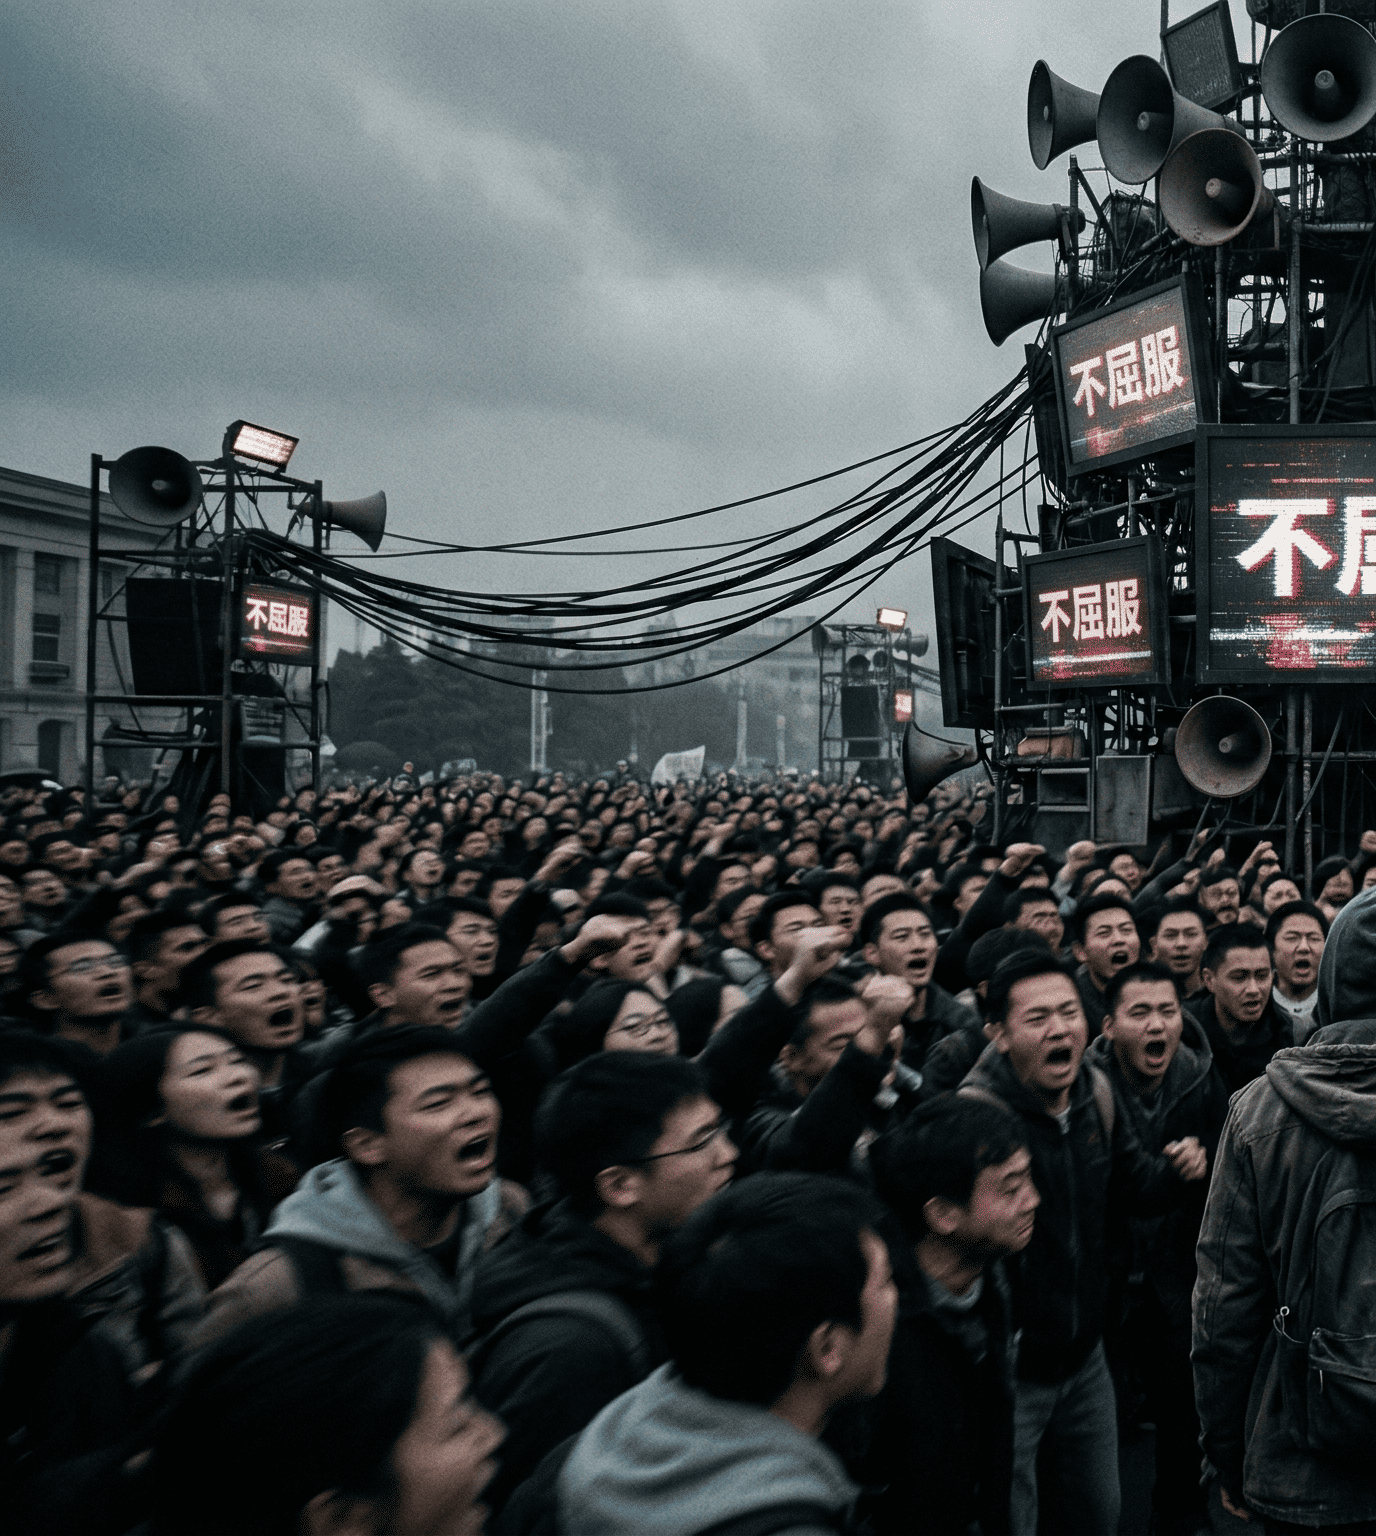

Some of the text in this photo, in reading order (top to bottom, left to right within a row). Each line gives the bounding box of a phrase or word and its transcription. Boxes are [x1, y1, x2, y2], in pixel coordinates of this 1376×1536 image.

[1070, 325, 1186, 417] 不屈服
[246, 598, 308, 637] 不屈服
[1039, 579, 1142, 642] 不屈服
